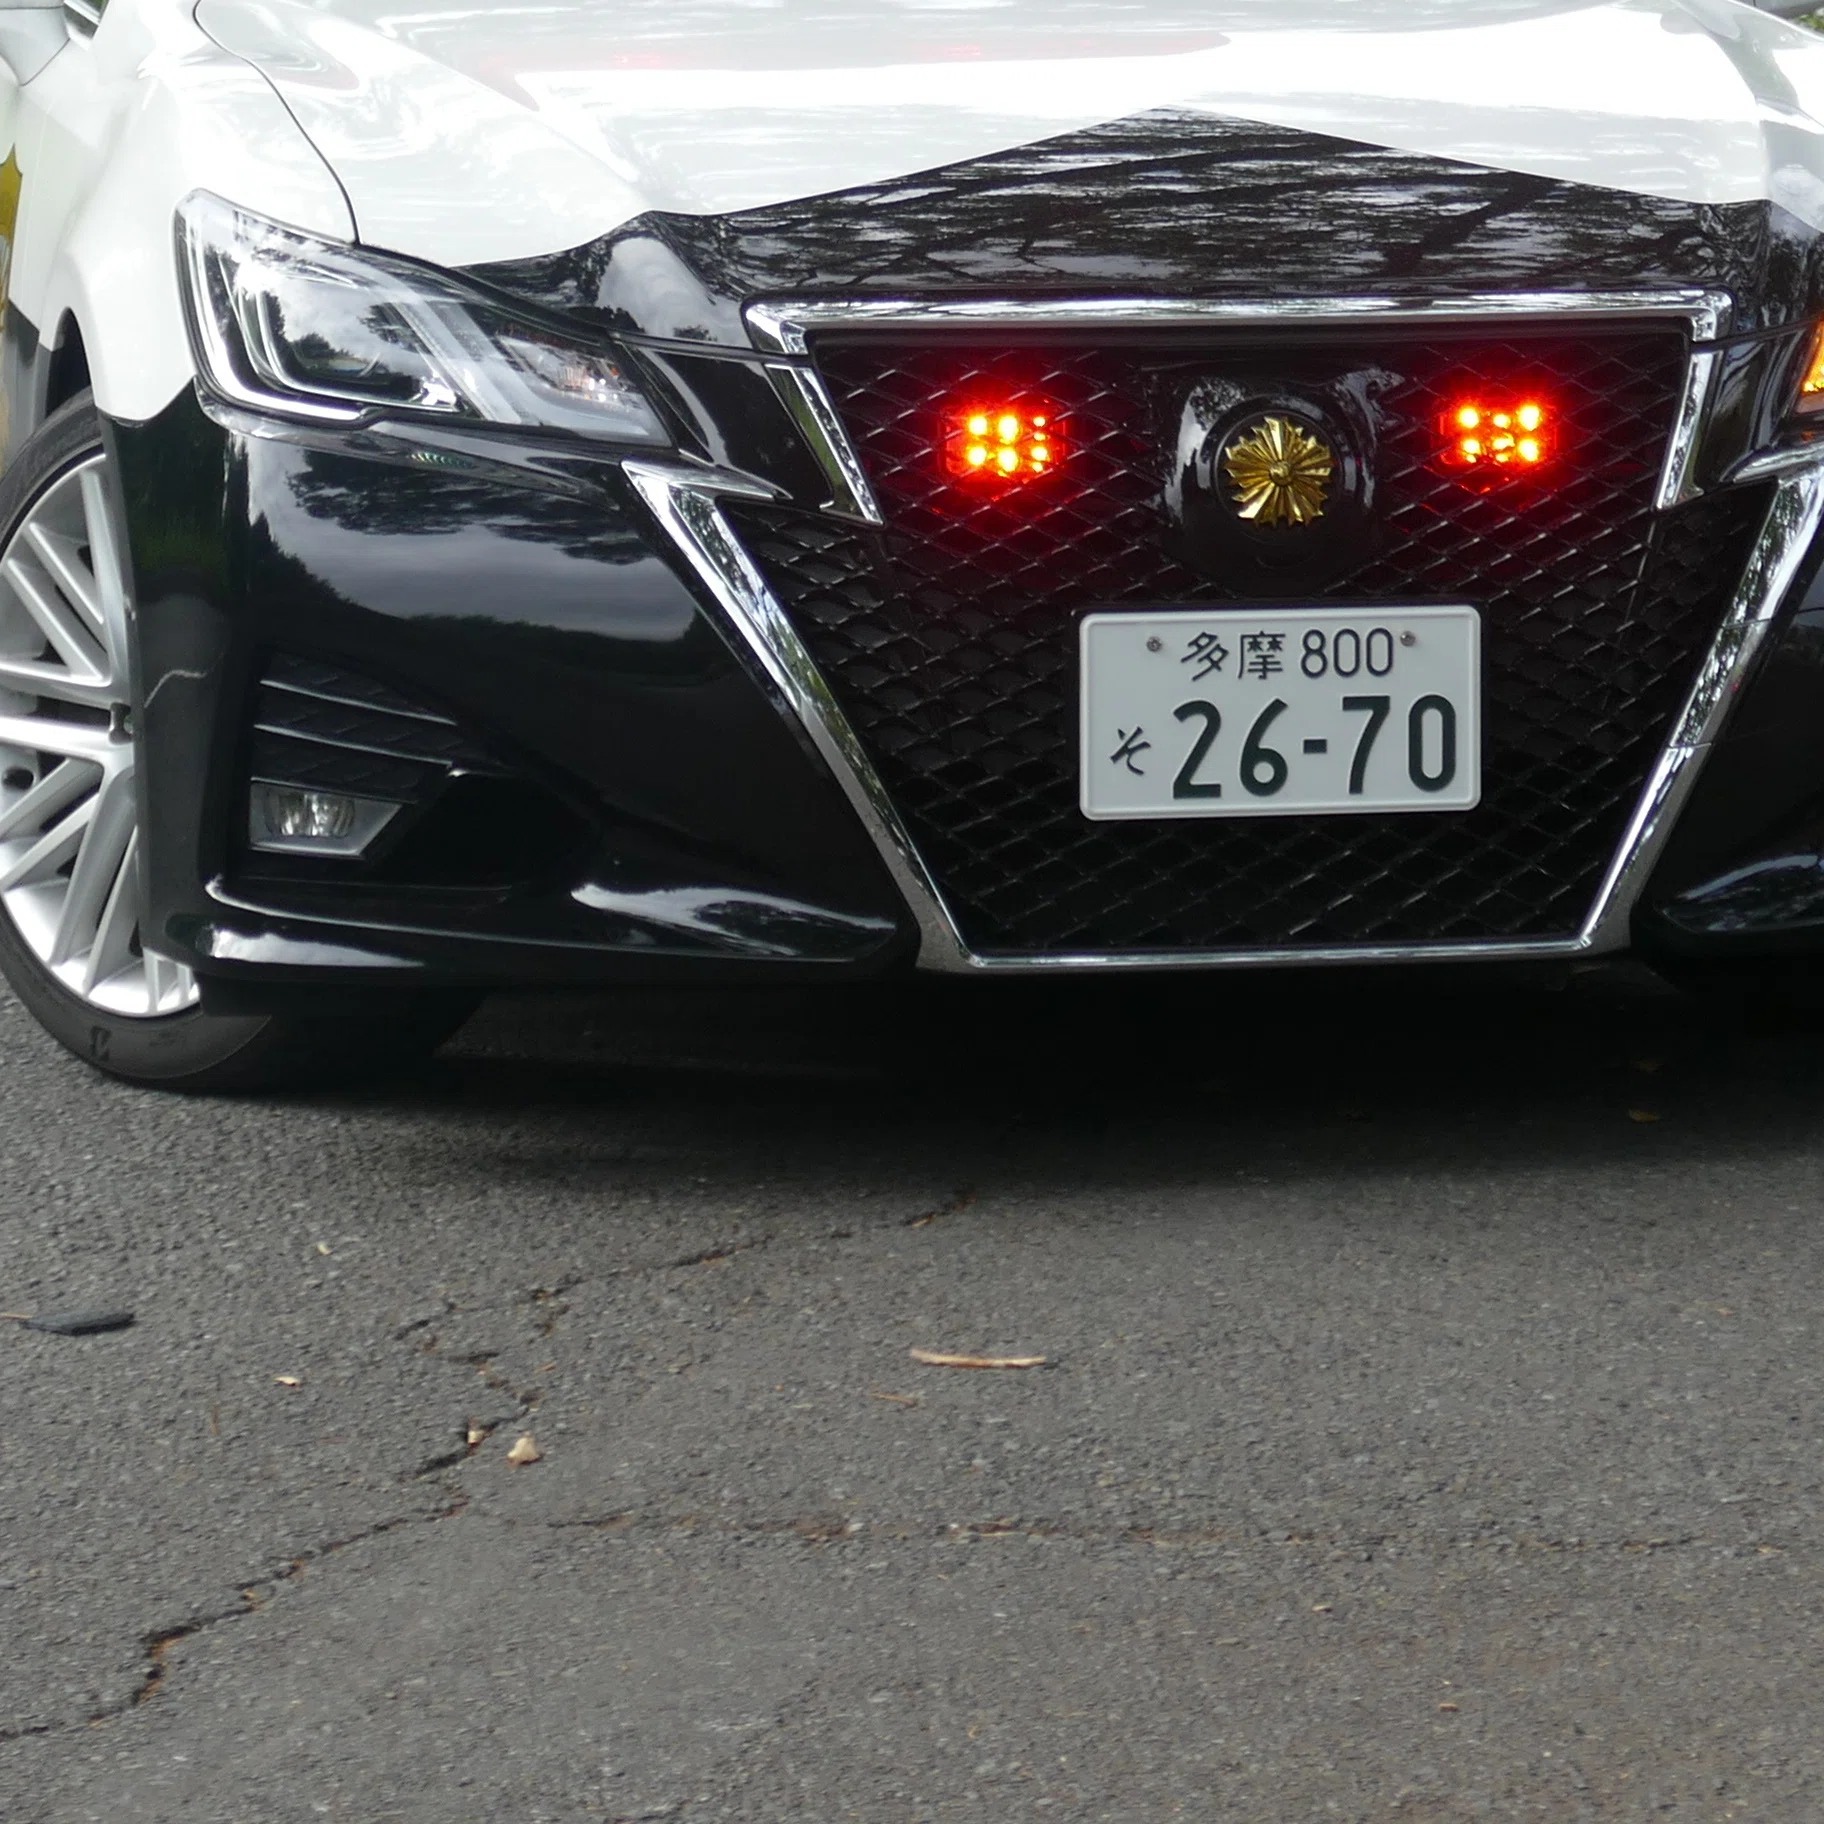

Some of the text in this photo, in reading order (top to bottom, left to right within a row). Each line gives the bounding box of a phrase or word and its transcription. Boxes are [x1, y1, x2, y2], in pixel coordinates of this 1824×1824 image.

[1180, 627, 1395, 681] 多摩 800
[1110, 693, 1457, 800] そ 26-70
